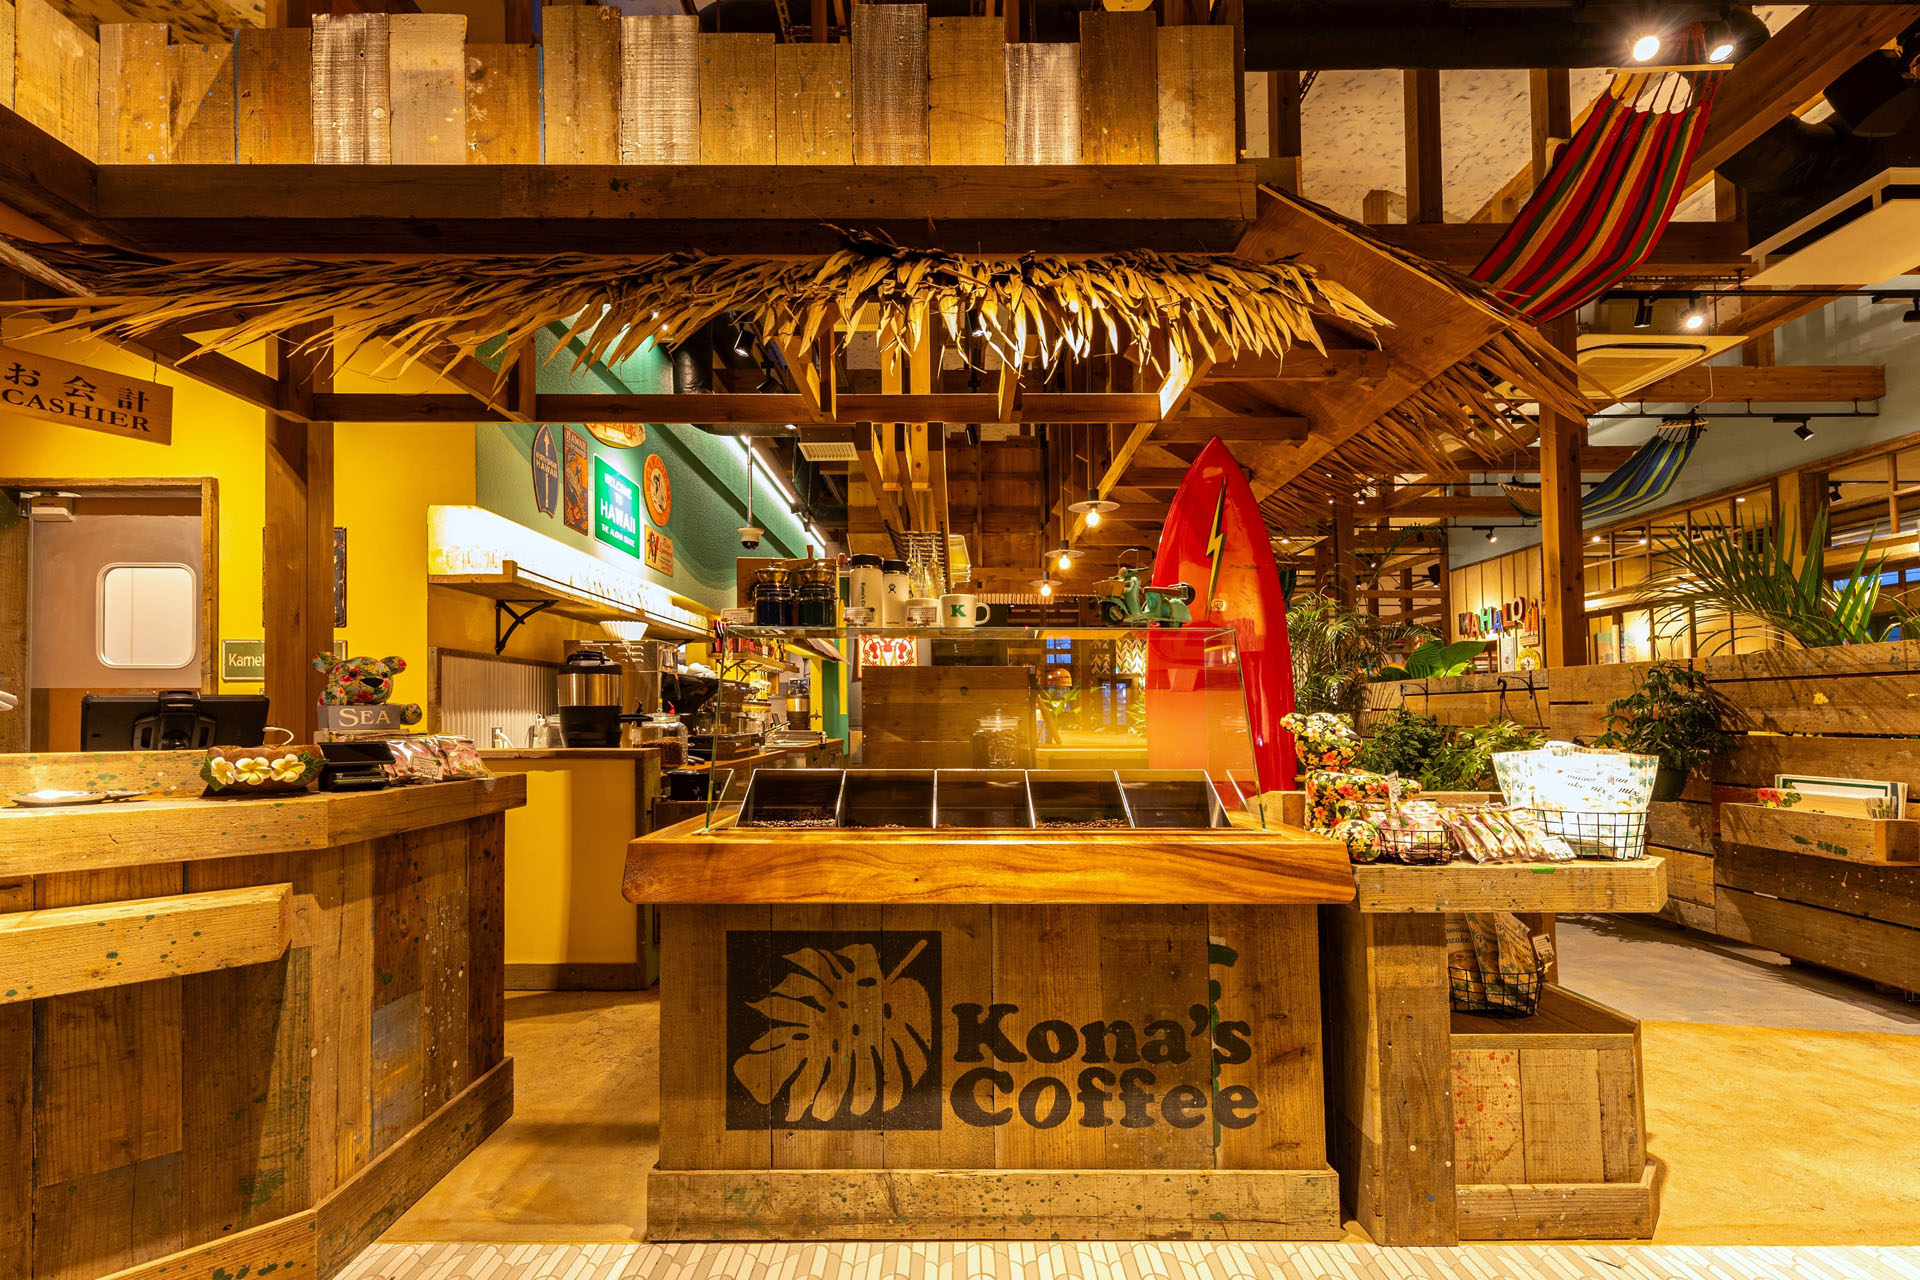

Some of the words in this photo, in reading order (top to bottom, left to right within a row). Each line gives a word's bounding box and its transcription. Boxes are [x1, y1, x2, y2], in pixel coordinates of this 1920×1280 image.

[4, 361, 150, 413] お会計
[2, 388, 151, 433] CASHIER
[604, 472, 633, 500] WELCOME
[614, 491, 623, 506] TO
[600, 497, 636, 535] HAWAII
[601, 523, 610, 534] THE
[950, 604, 967, 618] K
[1458, 597, 1526, 640] MAHALO
[1618, 786, 1640, 797] mix
[951, 1003, 1253, 1065] Kona's
[949, 1066, 1259, 1130] Coffee
